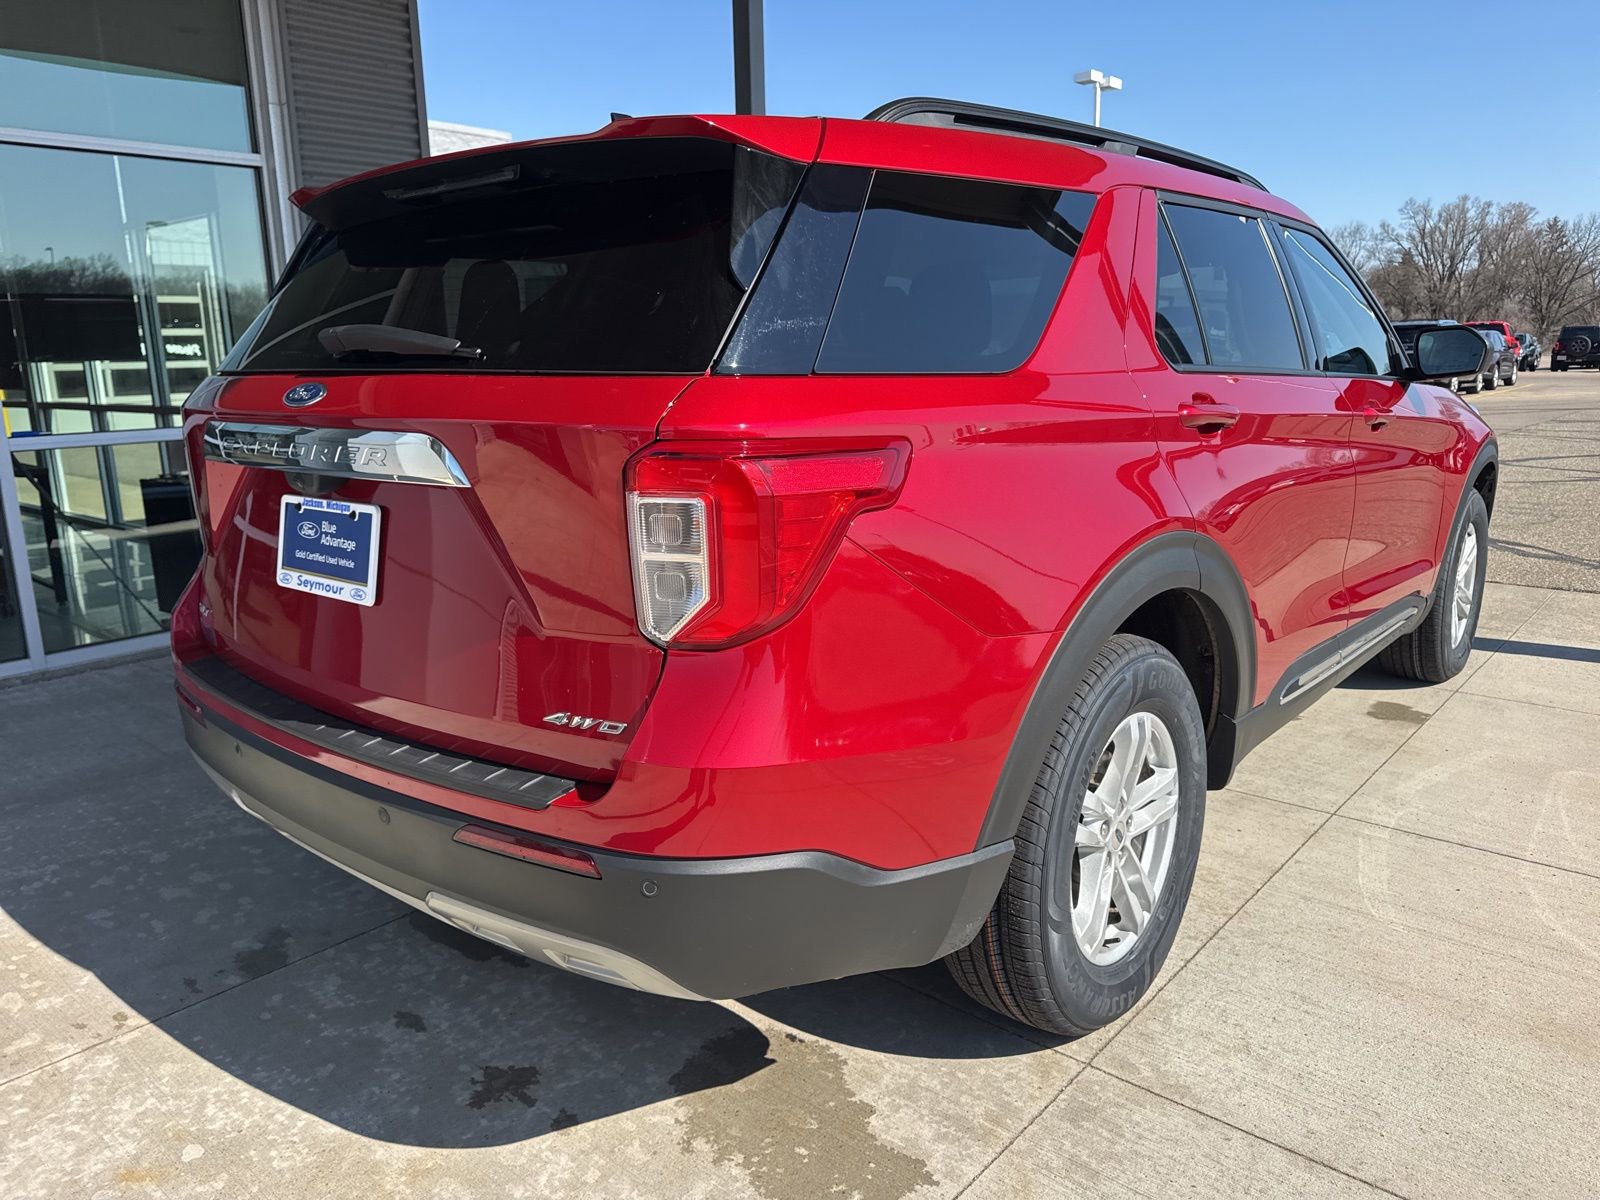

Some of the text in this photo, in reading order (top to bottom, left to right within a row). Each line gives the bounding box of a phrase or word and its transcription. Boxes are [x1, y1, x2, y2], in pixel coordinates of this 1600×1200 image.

[223, 438, 387, 467] EXPLORER
[327, 500, 351, 513] Michigan
[321, 521, 336, 534] Blue
[320, 534, 356, 552] Advantage
[295, 549, 355, 568] Gold Certified Used Vehicle
[297, 575, 344, 595] Seymour
[542, 712, 628, 735] 4WD
